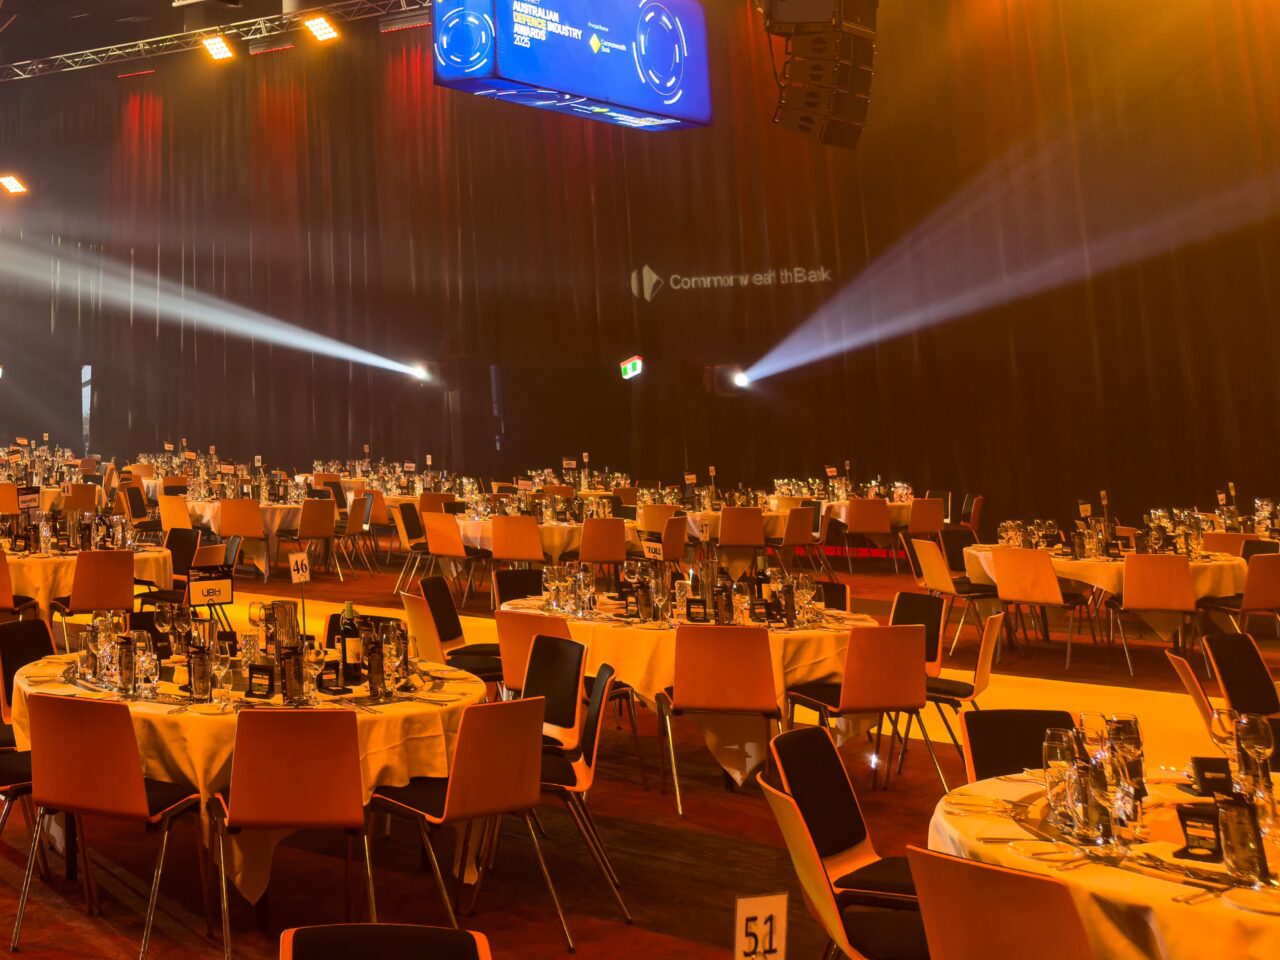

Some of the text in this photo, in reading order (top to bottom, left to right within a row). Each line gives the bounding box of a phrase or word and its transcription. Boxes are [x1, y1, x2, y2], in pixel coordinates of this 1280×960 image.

[513, 0, 559, 22] AUSTRALIAN
[514, 11, 546, 30] DEFENCE
[547, 21, 582, 40] INDUSTRY
[514, 23, 546, 41] AWARDS
[514, 34, 530, 48] 2025
[292, 559, 308, 574] 46
[743, 913, 778, 957] 51
